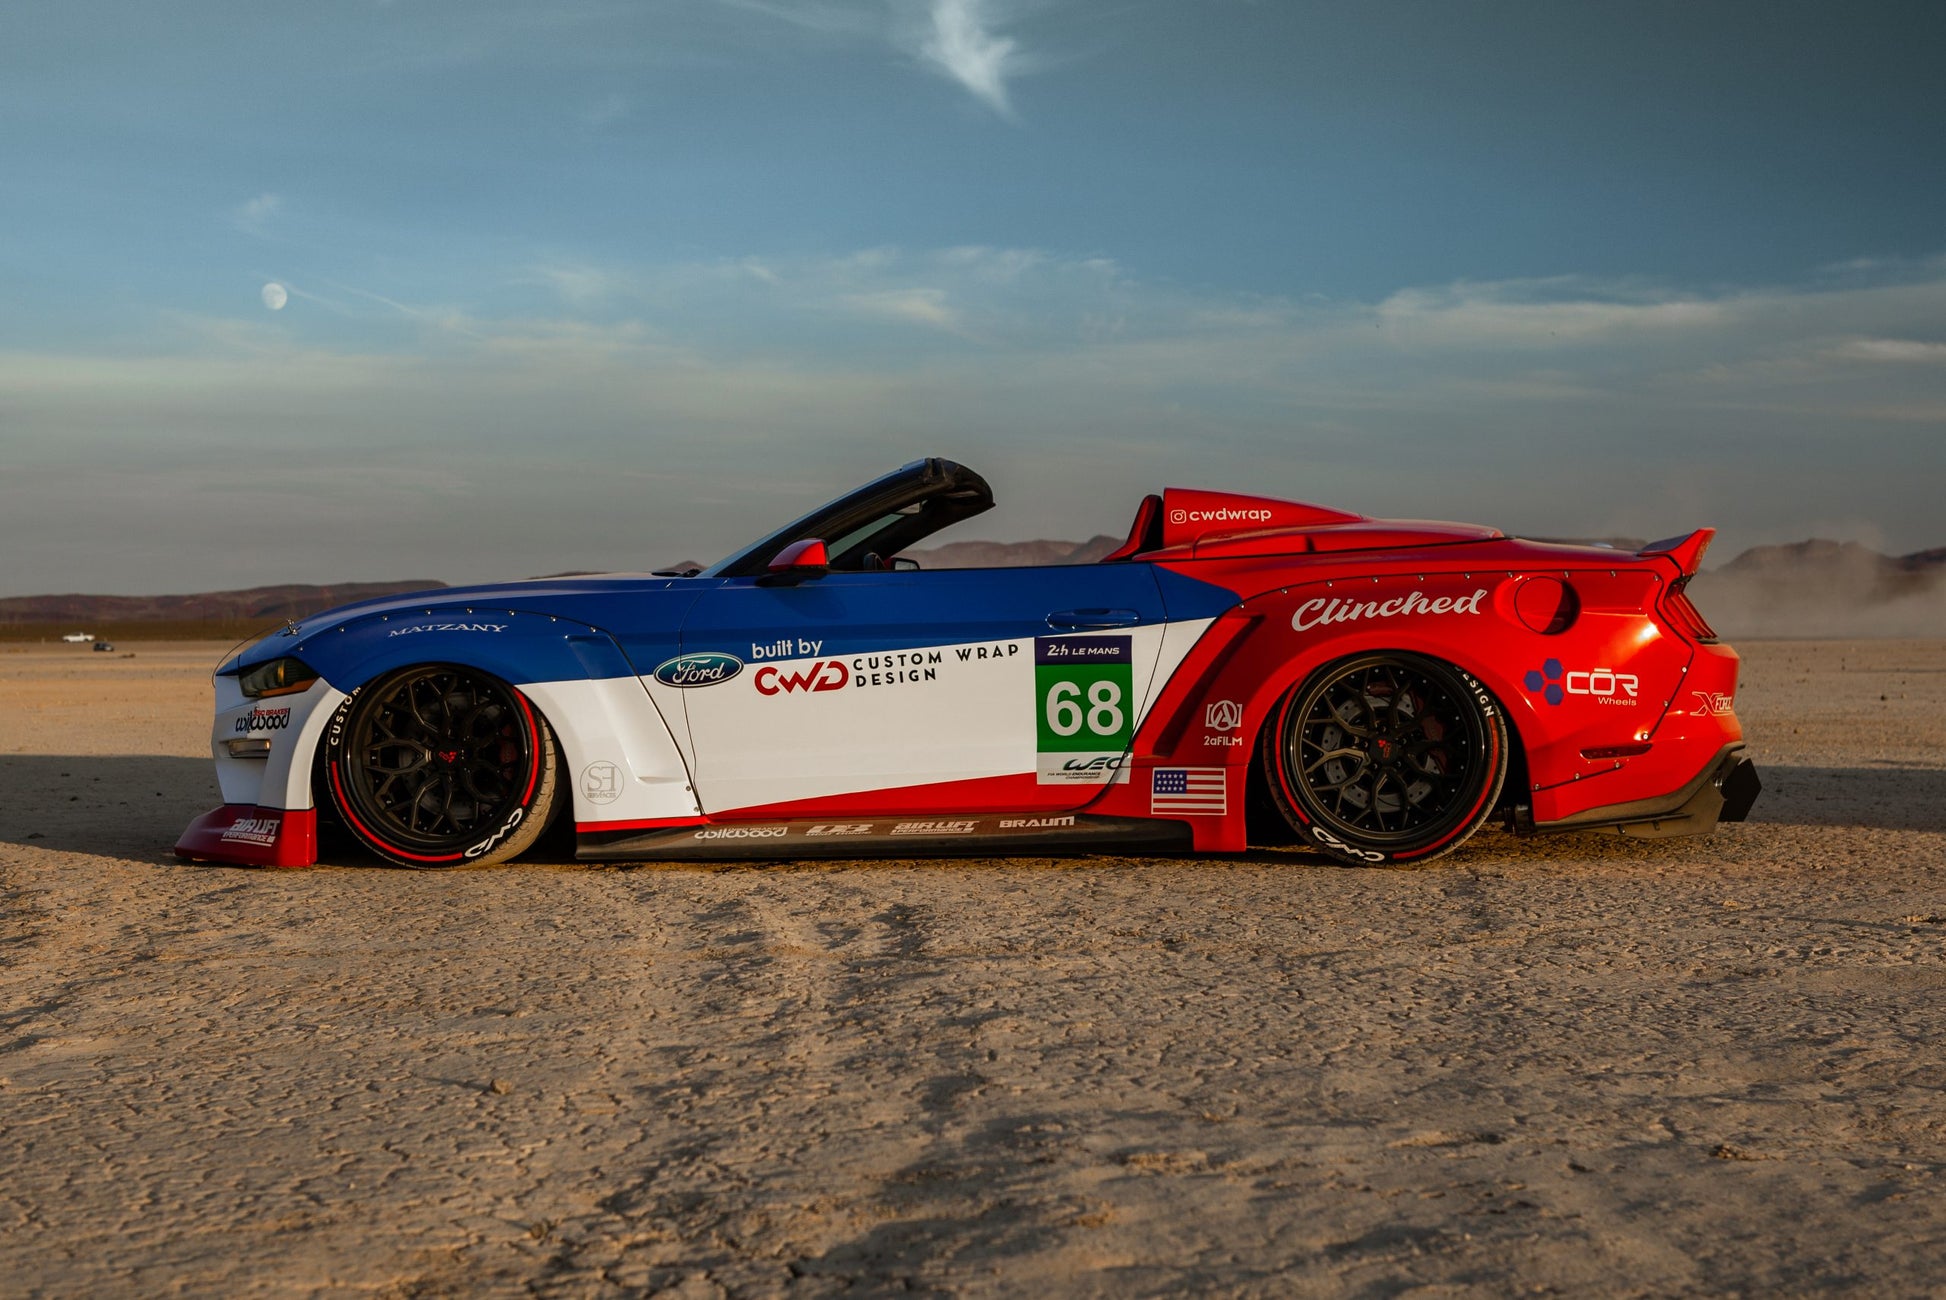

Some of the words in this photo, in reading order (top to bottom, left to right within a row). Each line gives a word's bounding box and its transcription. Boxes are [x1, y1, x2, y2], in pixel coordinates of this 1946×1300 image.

[1189, 507, 1272, 522] cwdwrap
[1291, 588, 1488, 632] Clinched
[388, 624, 508, 637] MATZANY
[751, 639, 793, 659] built
[798, 638, 823, 656] by
[853, 650, 943, 671] CUSTOM
[955, 643, 1020, 662] WRAP
[1087, 647, 1120, 655] MANS
[672, 657, 726, 684] Ford
[753, 660, 849, 696] CWD
[855, 667, 937, 688] DESIGN
[1454, 666, 1495, 717] ESIGN
[1597, 696, 1637, 706] Wheels
[330, 686, 361, 746] CUSTOM
[1046, 680, 1124, 737] 68
[1203, 735, 1243, 746] 2aFILM
[999, 816, 1075, 828] BRAUM
[694, 826, 788, 840] wilwood
